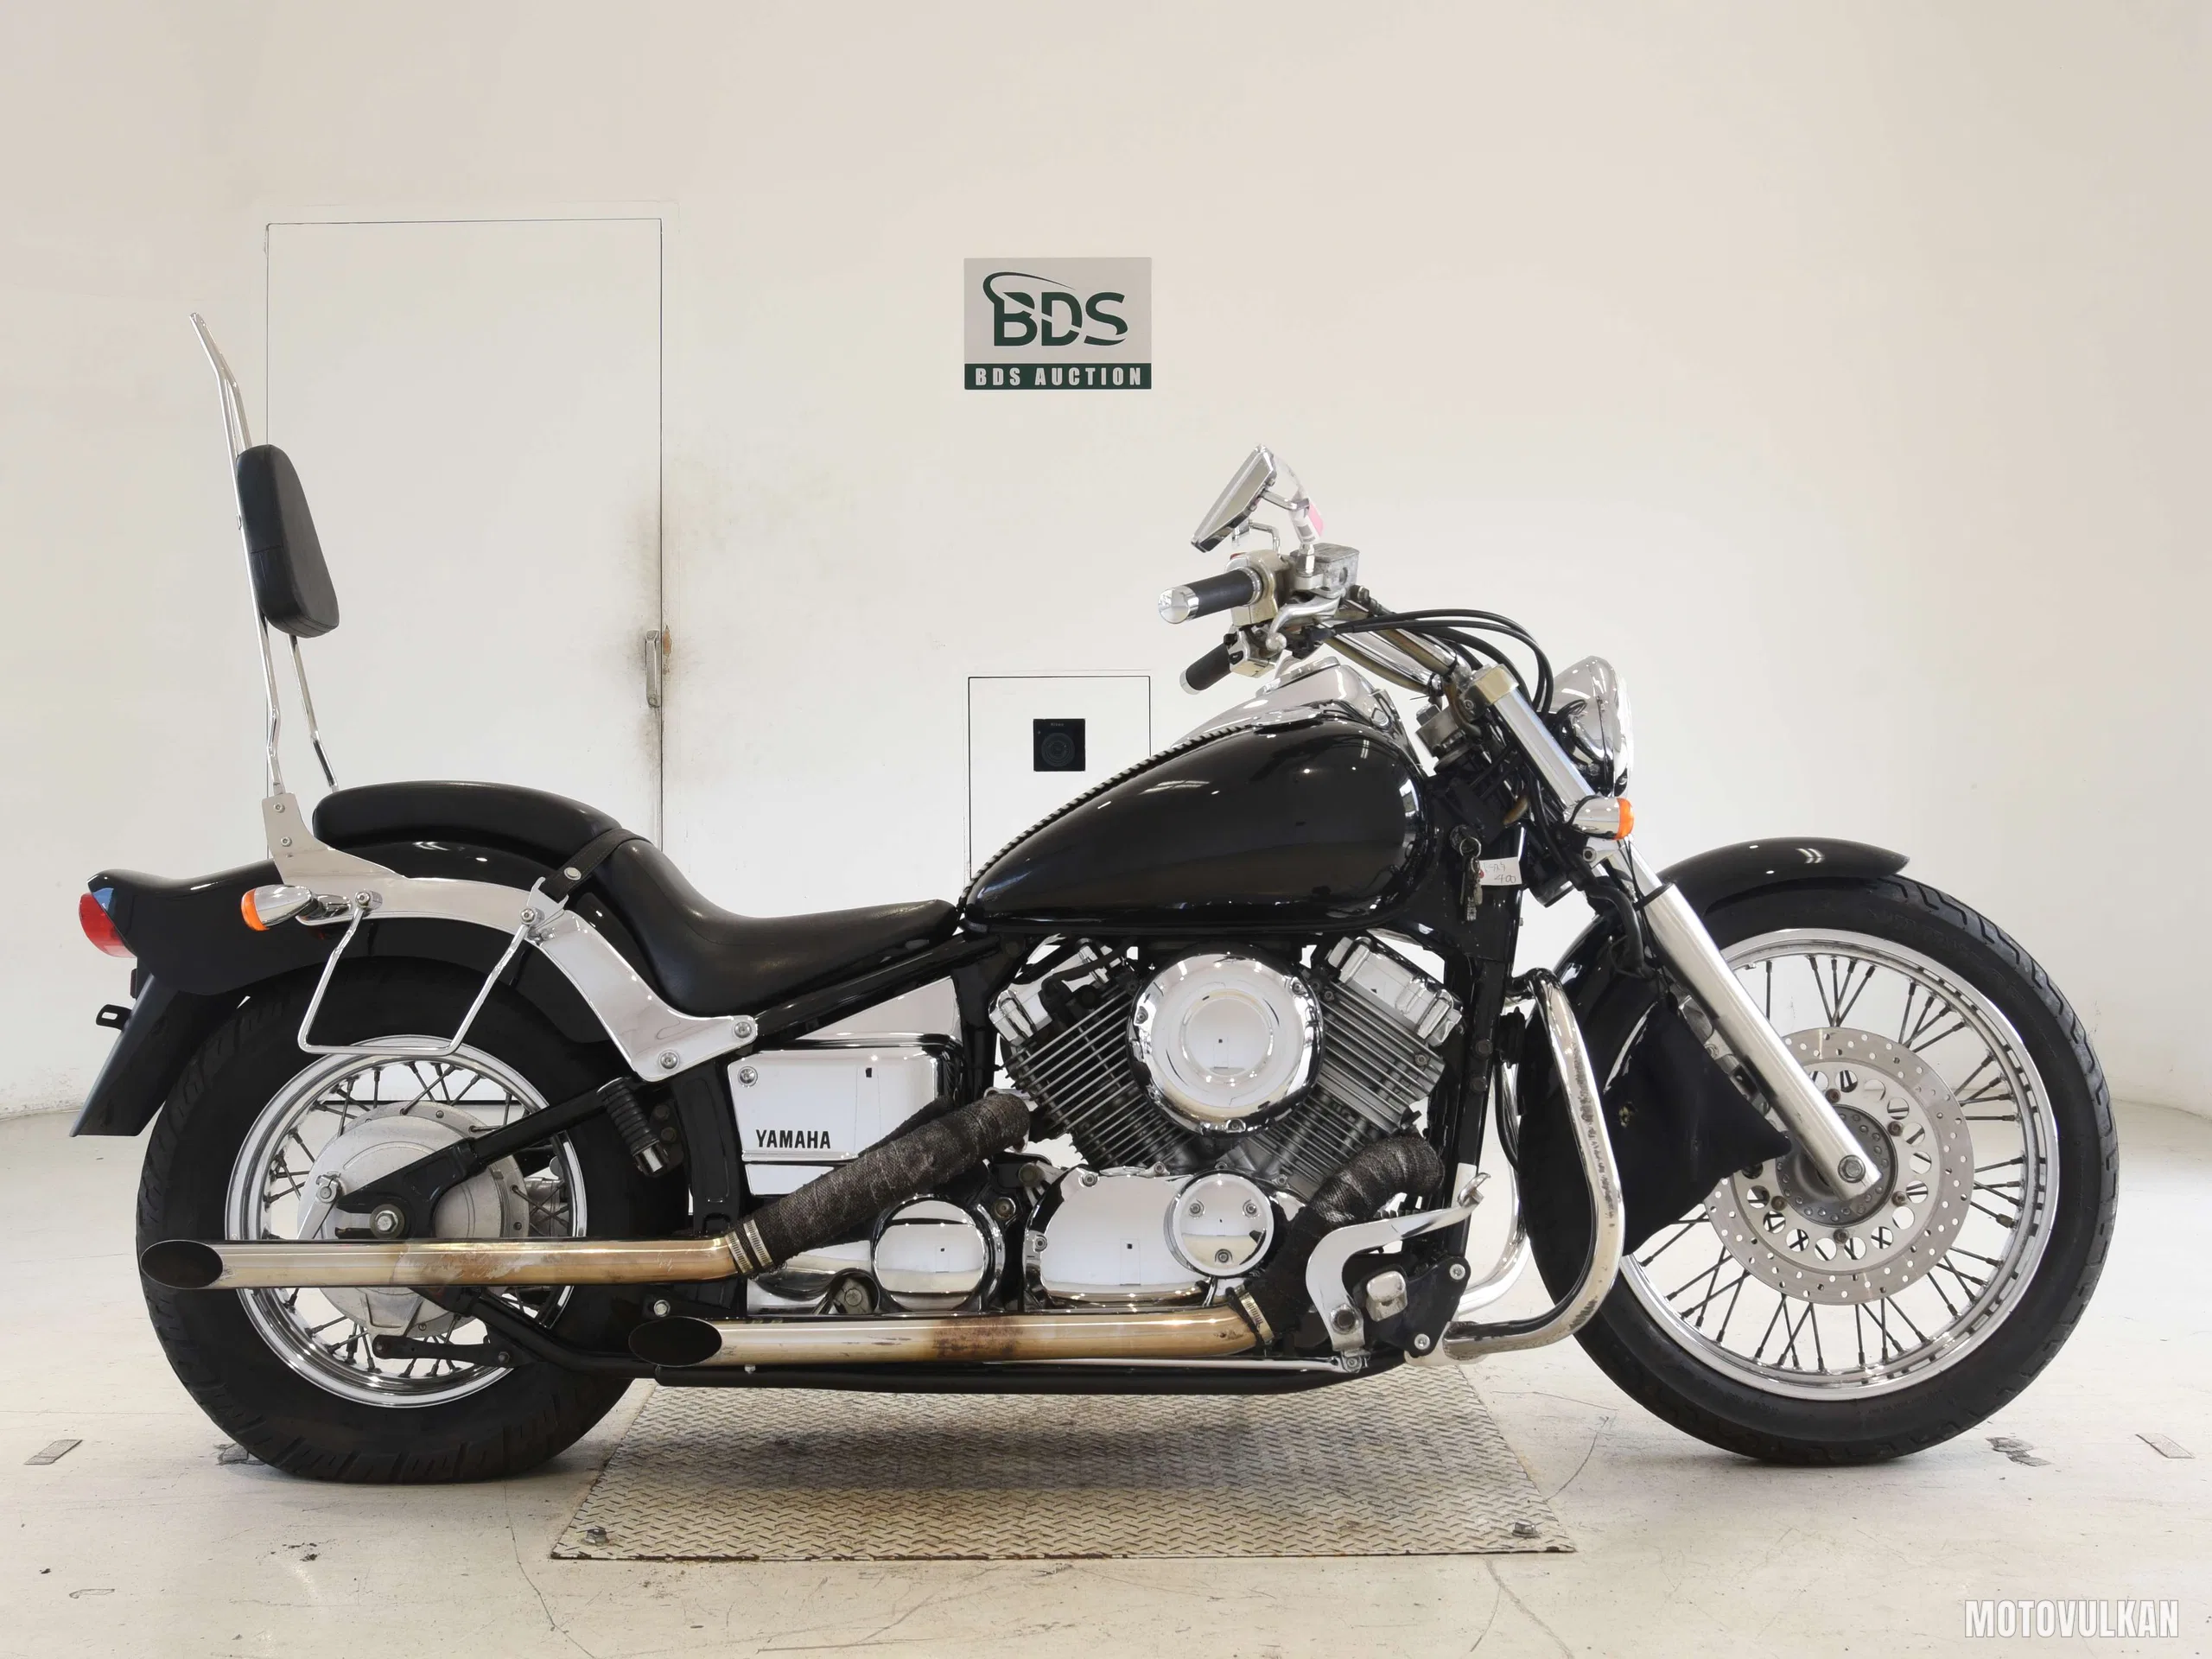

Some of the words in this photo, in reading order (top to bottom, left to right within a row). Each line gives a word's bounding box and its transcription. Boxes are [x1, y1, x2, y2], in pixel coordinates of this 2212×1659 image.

[983, 271, 1128, 346] BDS
[975, 366, 1020, 386] BDS
[1034, 366, 1141, 386] AUCTION
[755, 1129, 831, 1149] YAMAHA
